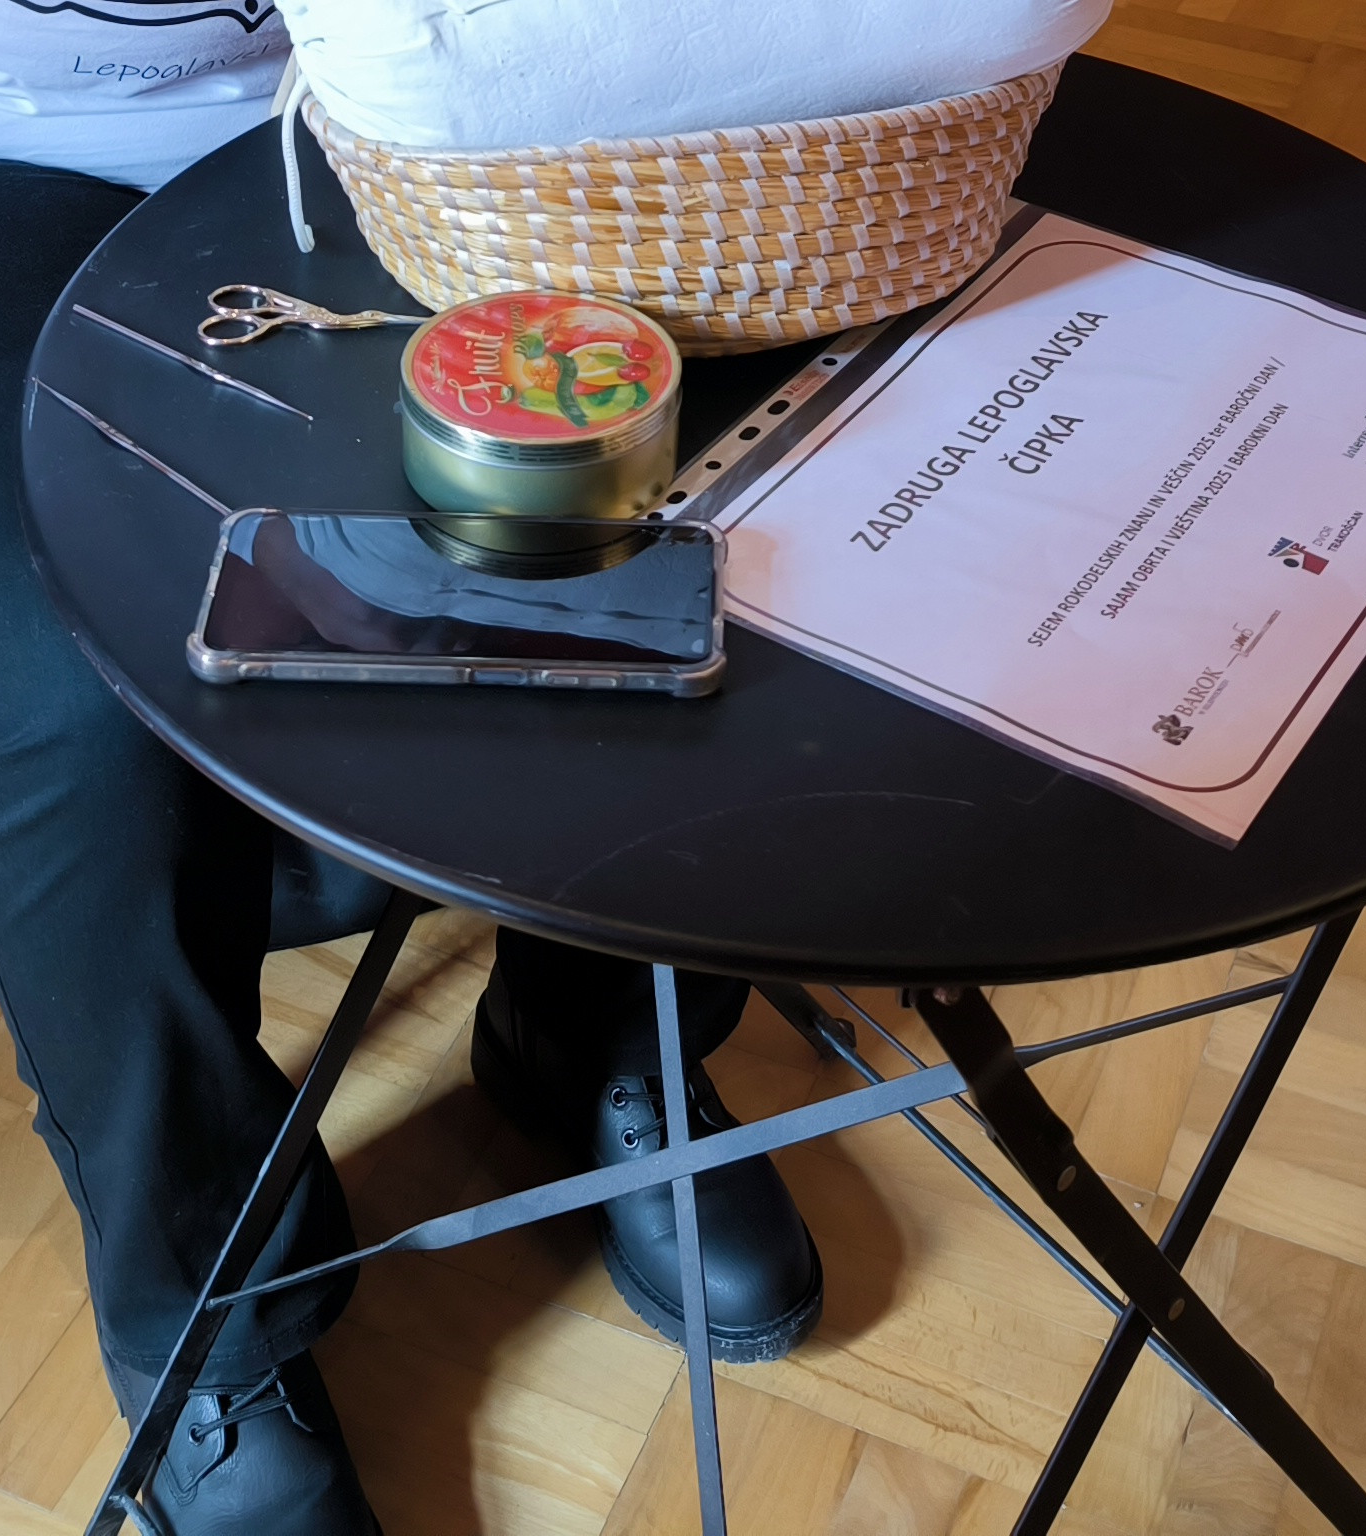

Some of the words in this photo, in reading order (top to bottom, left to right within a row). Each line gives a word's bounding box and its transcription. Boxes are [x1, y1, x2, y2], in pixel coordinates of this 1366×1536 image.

[849, 445, 976, 552] ZADRUGA
[957, 311, 1109, 444] LEPOGLAVSKA
[1262, 402, 1289, 425] DAN
[998, 414, 1084, 475] ČIPKA
[1227, 423, 1272, 466] BAROKNI
[1027, 611, 1067, 647] SEJEM
[1057, 539, 1128, 613] ROKODELSKIH
[1118, 506, 1156, 541] ZNANJ
[1147, 494, 1166, 509] IN
[1157, 459, 1196, 494] VEŠČIN
[1187, 436, 1216, 461] 2025
[1208, 422, 1228, 438] ter
[1219, 382, 1263, 424] BAROČNI
[1253, 363, 1279, 385] DAN
[1270, 355, 1286, 368] /
[1203, 469, 1232, 496] 2025
[1165, 495, 1213, 540] VJEŠTINA
[1132, 546, 1171, 582] OBRTA
[1160, 539, 1176, 547] I
[1100, 581, 1141, 620] SAJAM
[1173, 666, 1224, 717] BAROK
